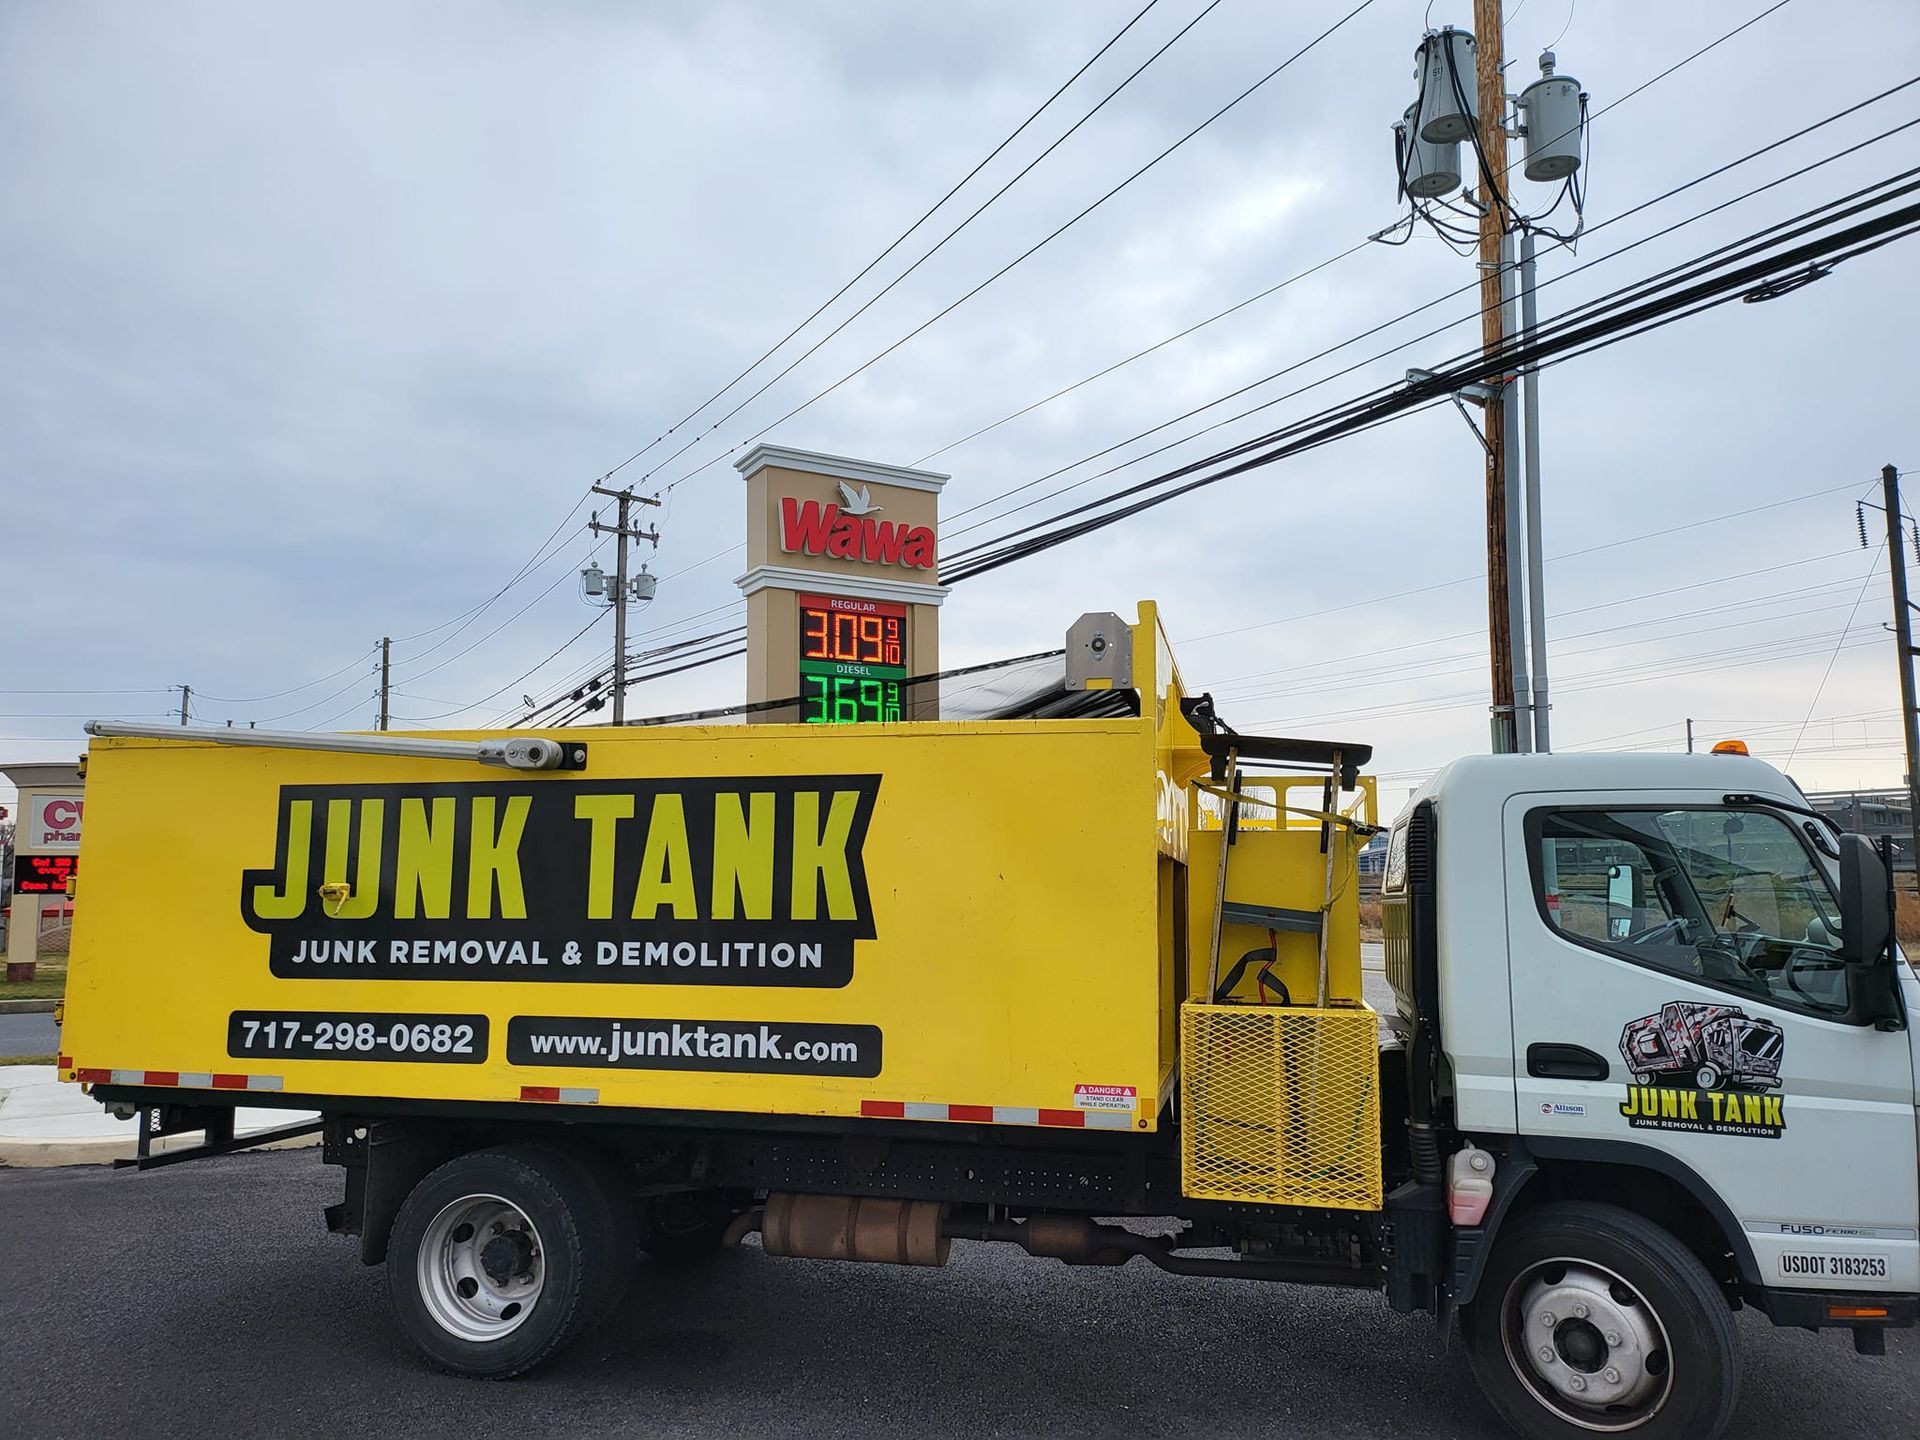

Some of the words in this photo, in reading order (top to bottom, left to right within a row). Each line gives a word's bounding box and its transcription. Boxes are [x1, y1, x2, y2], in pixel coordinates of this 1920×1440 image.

[780, 497, 935, 569] Wawa
[831, 599, 876, 612] REGULAR
[806, 610, 883, 663] 3.09
[836, 664, 871, 676] DIESEL
[253, 795, 533, 920] JUNK
[574, 790, 861, 921] TANK
[292, 939, 378, 965] JUNK
[390, 940, 549, 966] REMOVAL
[561, 940, 583, 966] &
[596, 941, 823, 969] DEMOLITION
[241, 1020, 474, 1055] 717-298-0682
[530, 1023, 858, 1064] www.junktank.com
[1088, 1086, 1122, 1095] DANGER
[1553, 1104, 1584, 1112] Allison
[1623, 1086, 1698, 1120] JUNK
[1707, 1092, 1783, 1126] TANK
[1634, 1119, 1659, 1127] JUNK
[1661, 1121, 1704, 1131] REMOVAL
[1716, 1125, 1775, 1136] DEMOLITION
[1780, 1224, 1824, 1235] FUSO
[1782, 1255, 1825, 1274] USDOT
[1829, 1257, 1886, 1276] 3183253
